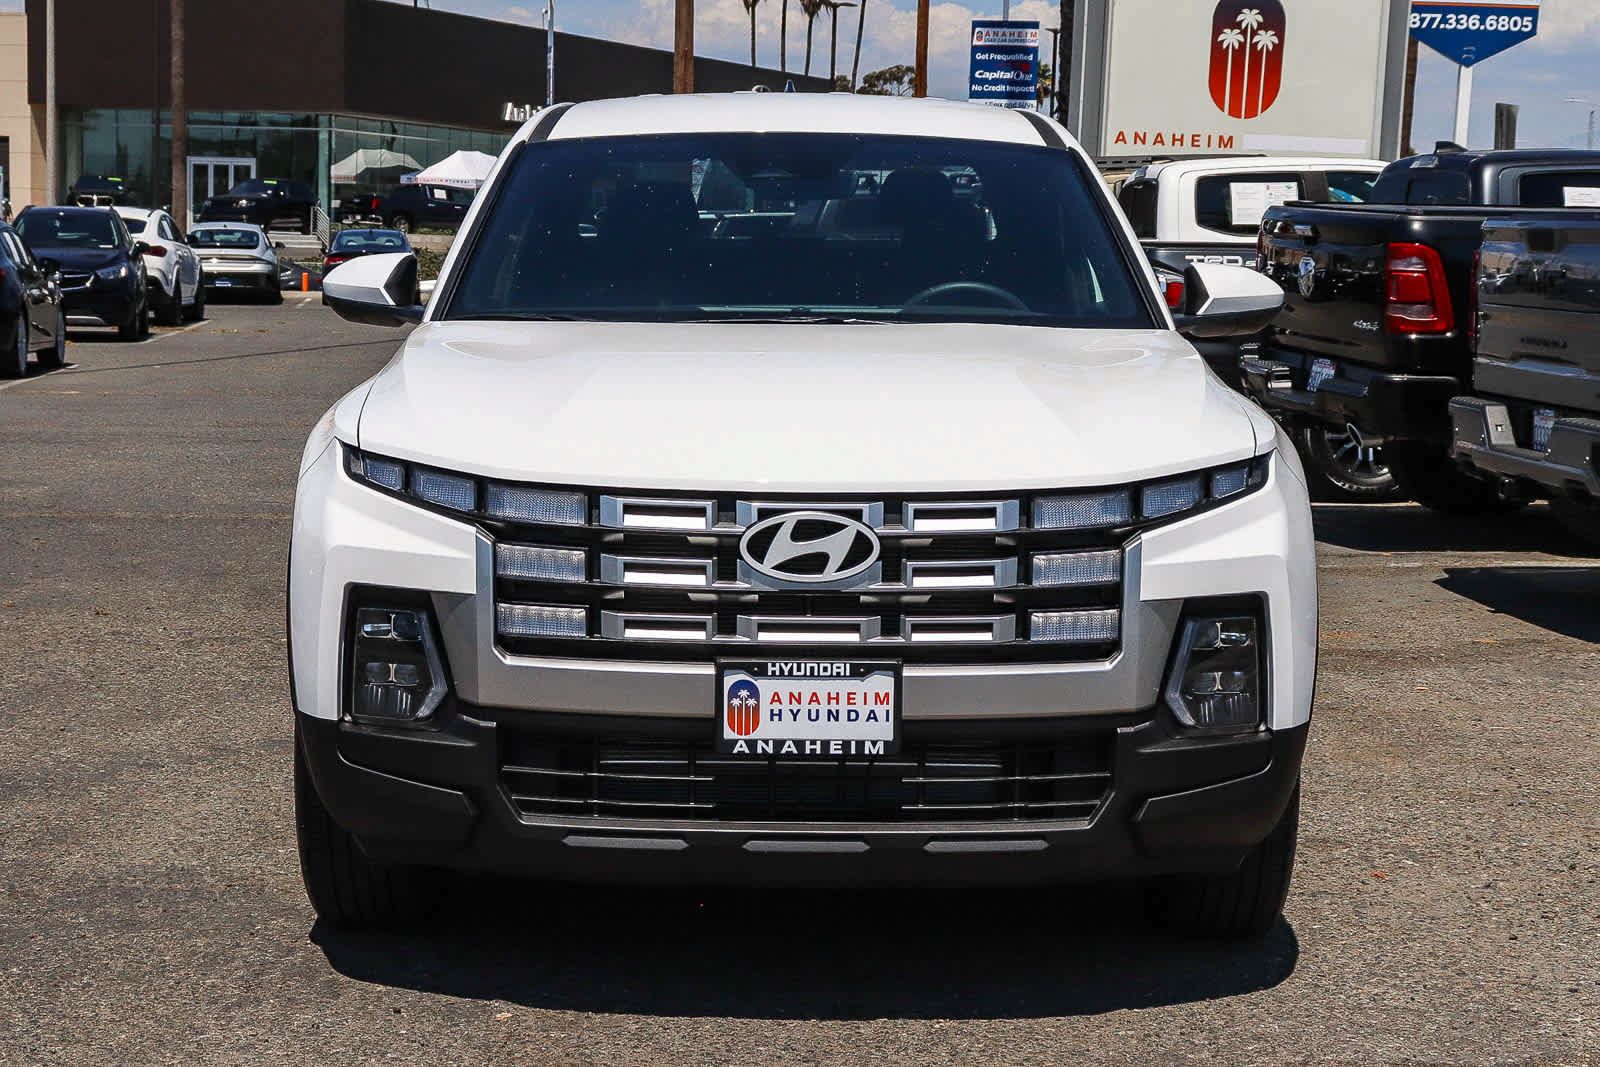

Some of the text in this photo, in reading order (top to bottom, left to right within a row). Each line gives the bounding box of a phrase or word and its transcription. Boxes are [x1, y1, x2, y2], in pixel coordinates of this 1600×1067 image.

[1410, 12, 1533, 32] 877.336.6805
[990, 53, 1033, 61] Prequalified
[1114, 130, 1234, 149] ANAHEIM
[768, 663, 850, 676] HYUNDAI
[769, 692, 890, 705] ANAHEIM
[769, 709, 890, 722] HYUNDAI
[732, 740, 885, 754] ANAHEIM
